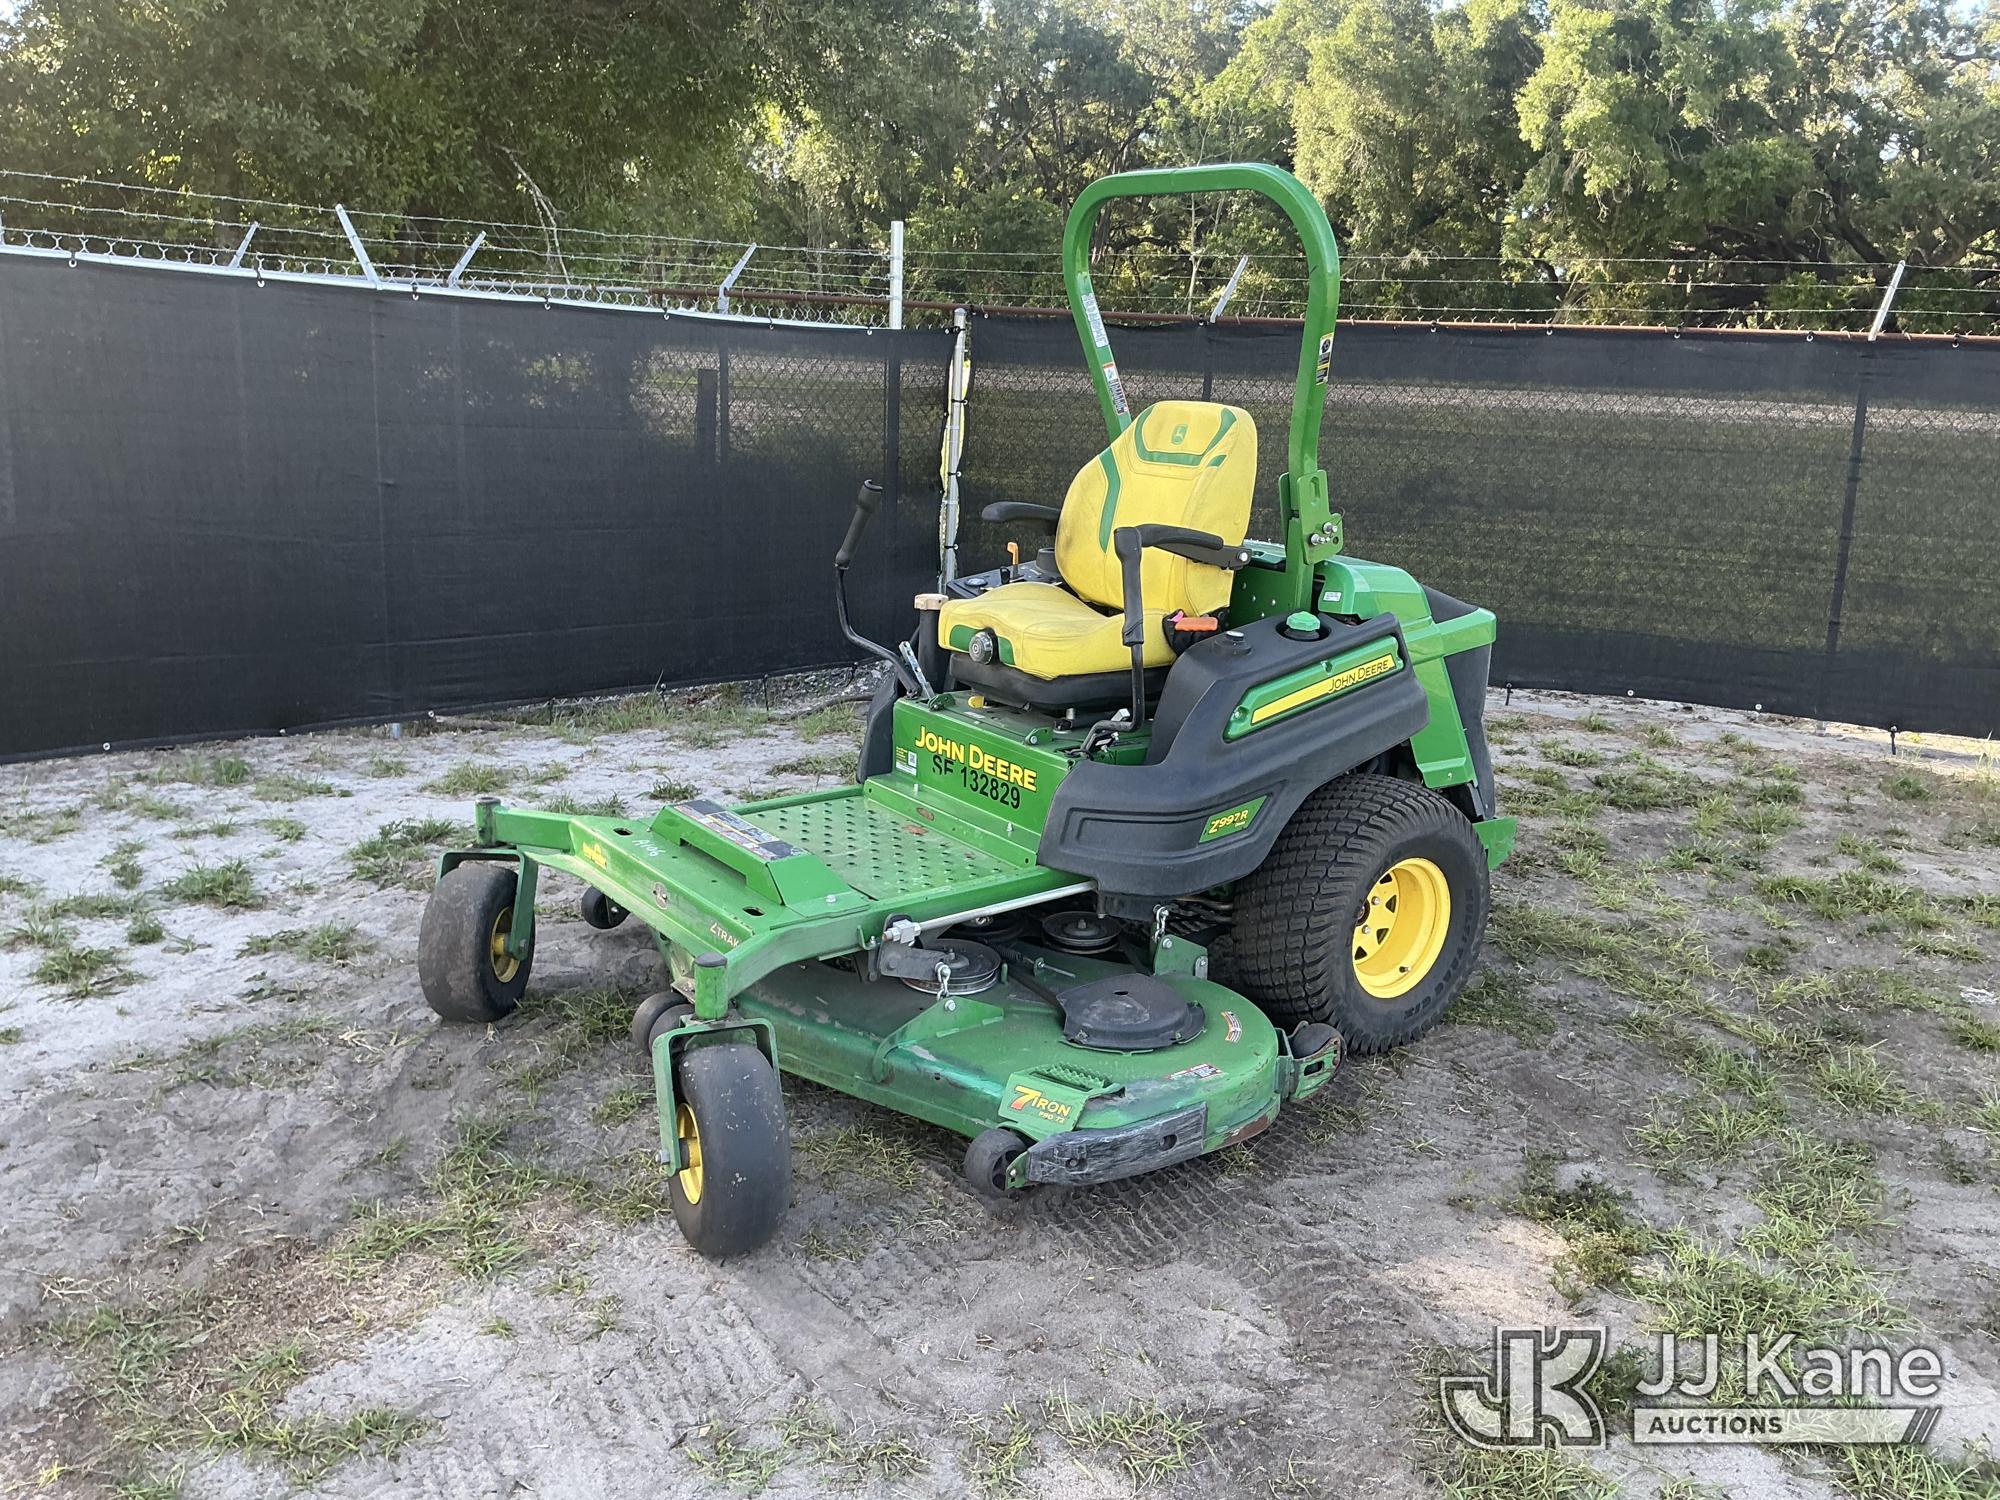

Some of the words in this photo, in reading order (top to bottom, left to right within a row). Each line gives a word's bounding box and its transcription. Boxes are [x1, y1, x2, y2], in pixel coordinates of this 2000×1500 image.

[1328, 672, 1356, 692] JOHN
[1358, 659, 1389, 680] DEERE
[915, 725, 965, 765] JOHN
[968, 743, 1038, 792] DEERE
[960, 766, 1021, 810] 132829
[1208, 809, 1249, 834] Z997R
[1010, 1085, 1042, 1110] 7
[1032, 1097, 1072, 1116] IRON
